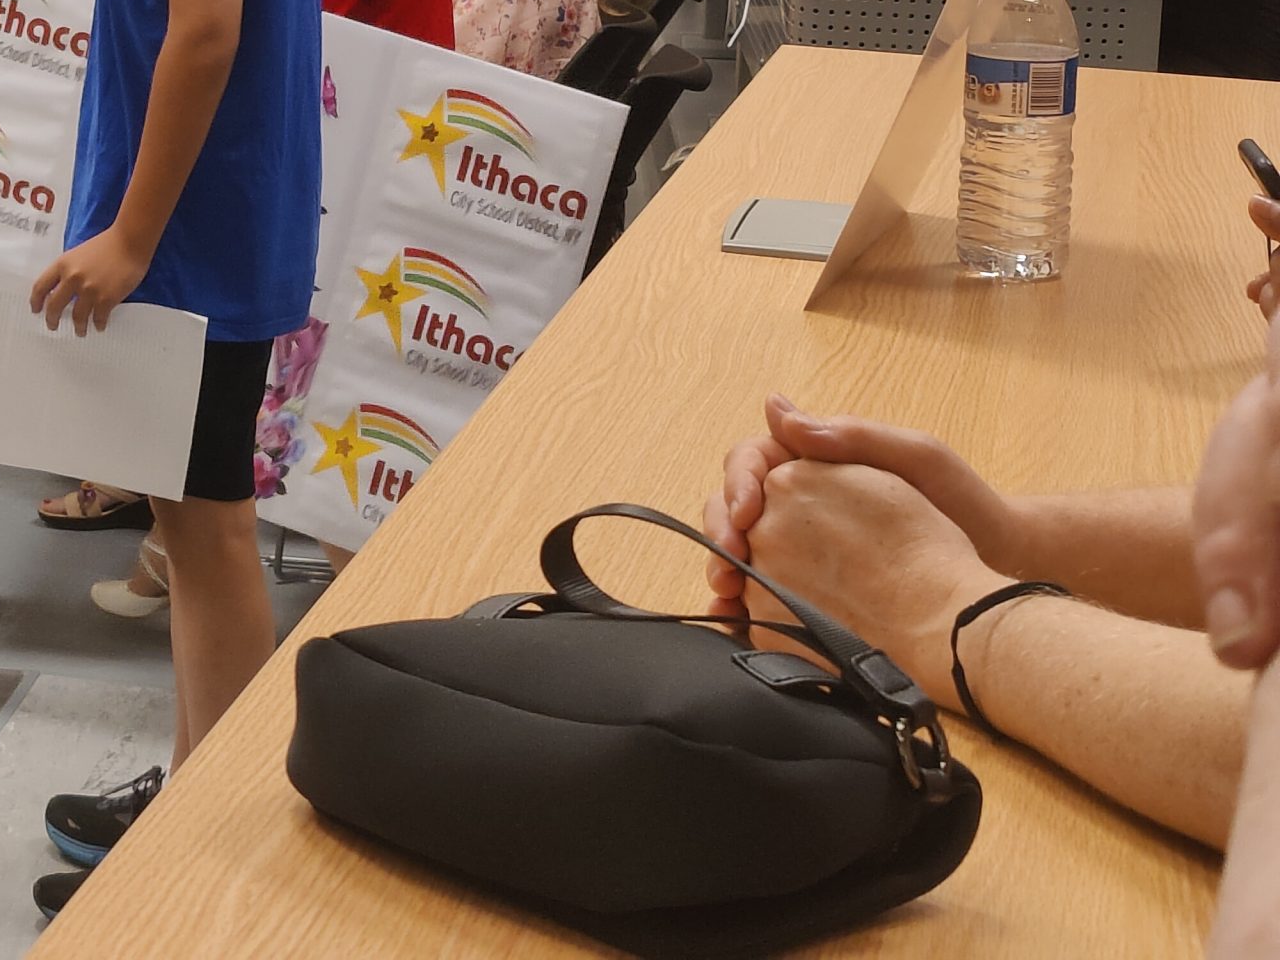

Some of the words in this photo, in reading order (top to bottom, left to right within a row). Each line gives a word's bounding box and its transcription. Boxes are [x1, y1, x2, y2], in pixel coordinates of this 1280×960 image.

[450, 190, 474, 214] City
[476, 198, 517, 224] School
[456, 144, 588, 221] Ithaca
[406, 349, 429, 374] City
[412, 303, 524, 371] Ithac
